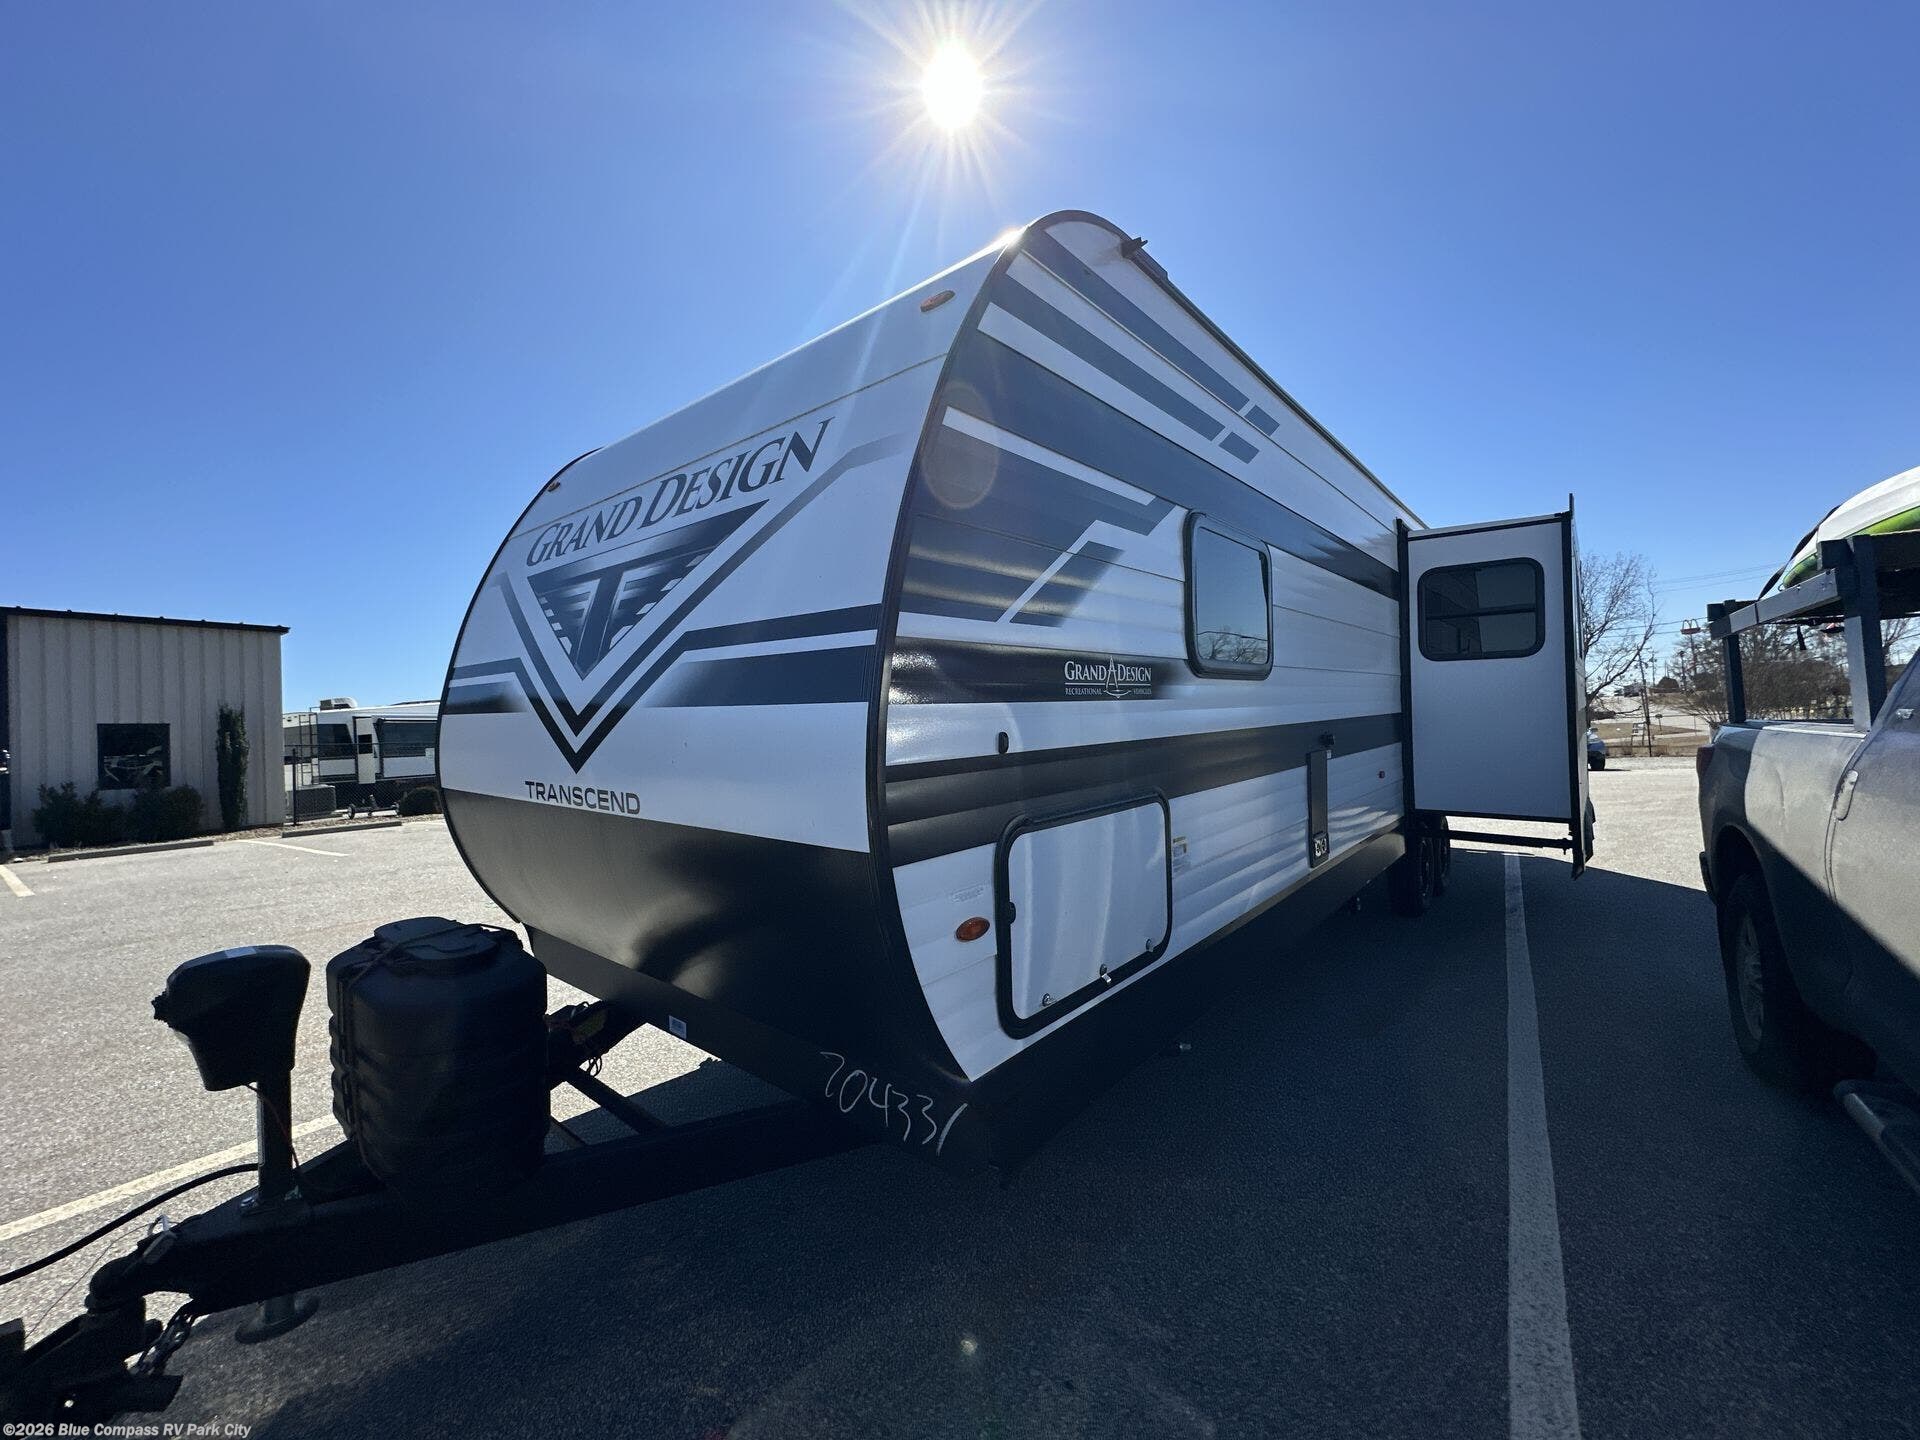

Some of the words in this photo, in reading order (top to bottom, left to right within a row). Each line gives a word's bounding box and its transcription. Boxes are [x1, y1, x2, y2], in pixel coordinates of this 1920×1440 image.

[525, 496, 643, 567] GRAND
[637, 416, 835, 529] DESIGN
[1064, 660, 1107, 681] GRAND
[1117, 663, 1152, 682] DESIGN
[1065, 687, 1103, 696] RECREATIONAL
[524, 780, 641, 815] TRANSCEND
